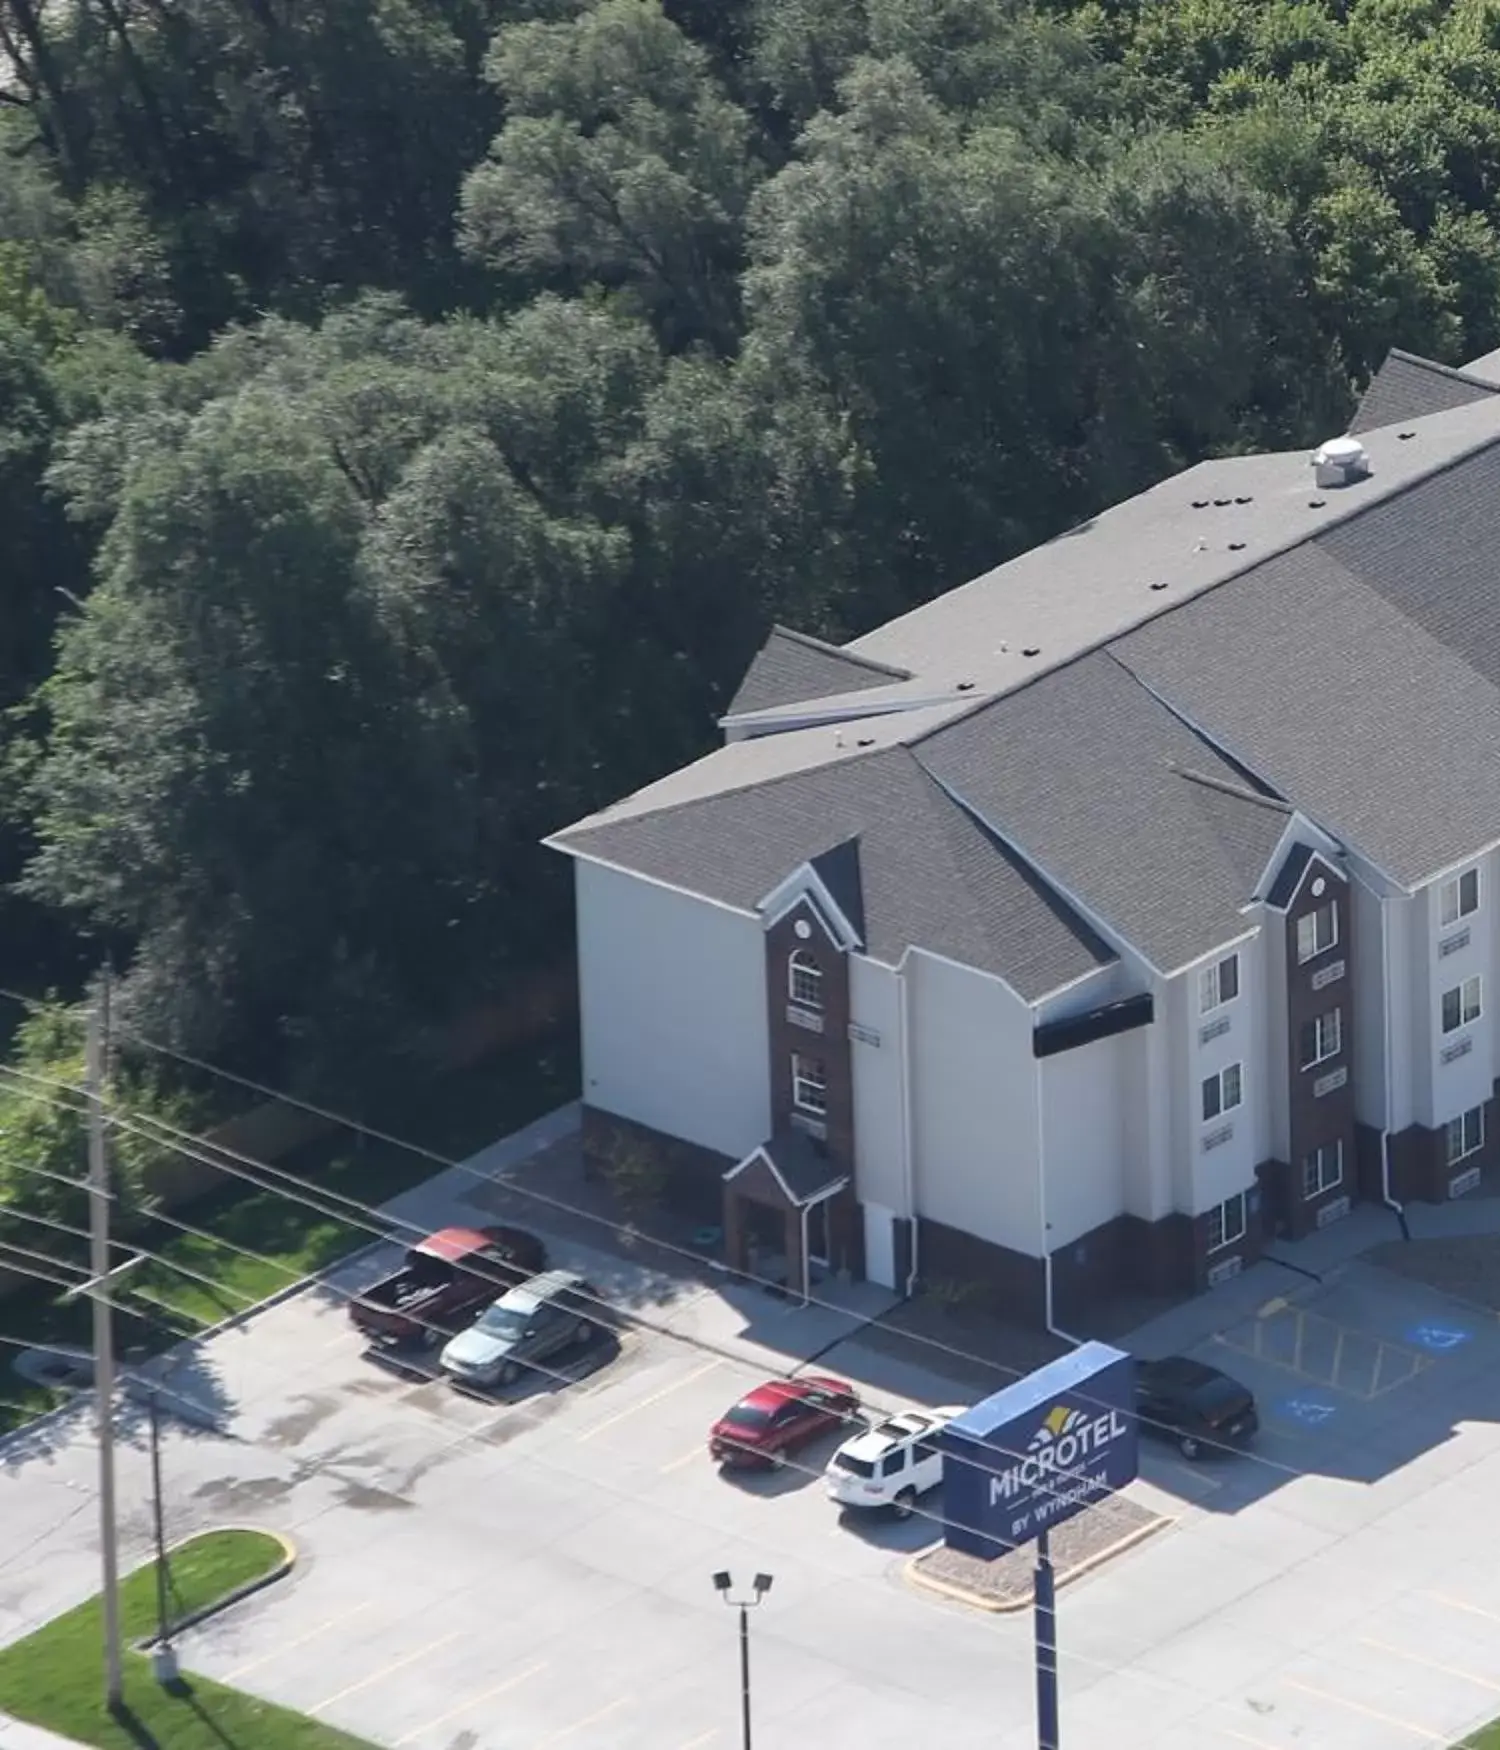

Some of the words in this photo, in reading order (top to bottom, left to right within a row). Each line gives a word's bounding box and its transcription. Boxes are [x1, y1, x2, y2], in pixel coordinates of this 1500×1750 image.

[990, 1410, 1126, 1506] MICROTEL
[1012, 1512, 1031, 1536] BY
[1034, 1471, 1107, 1521] WYNDHAM
